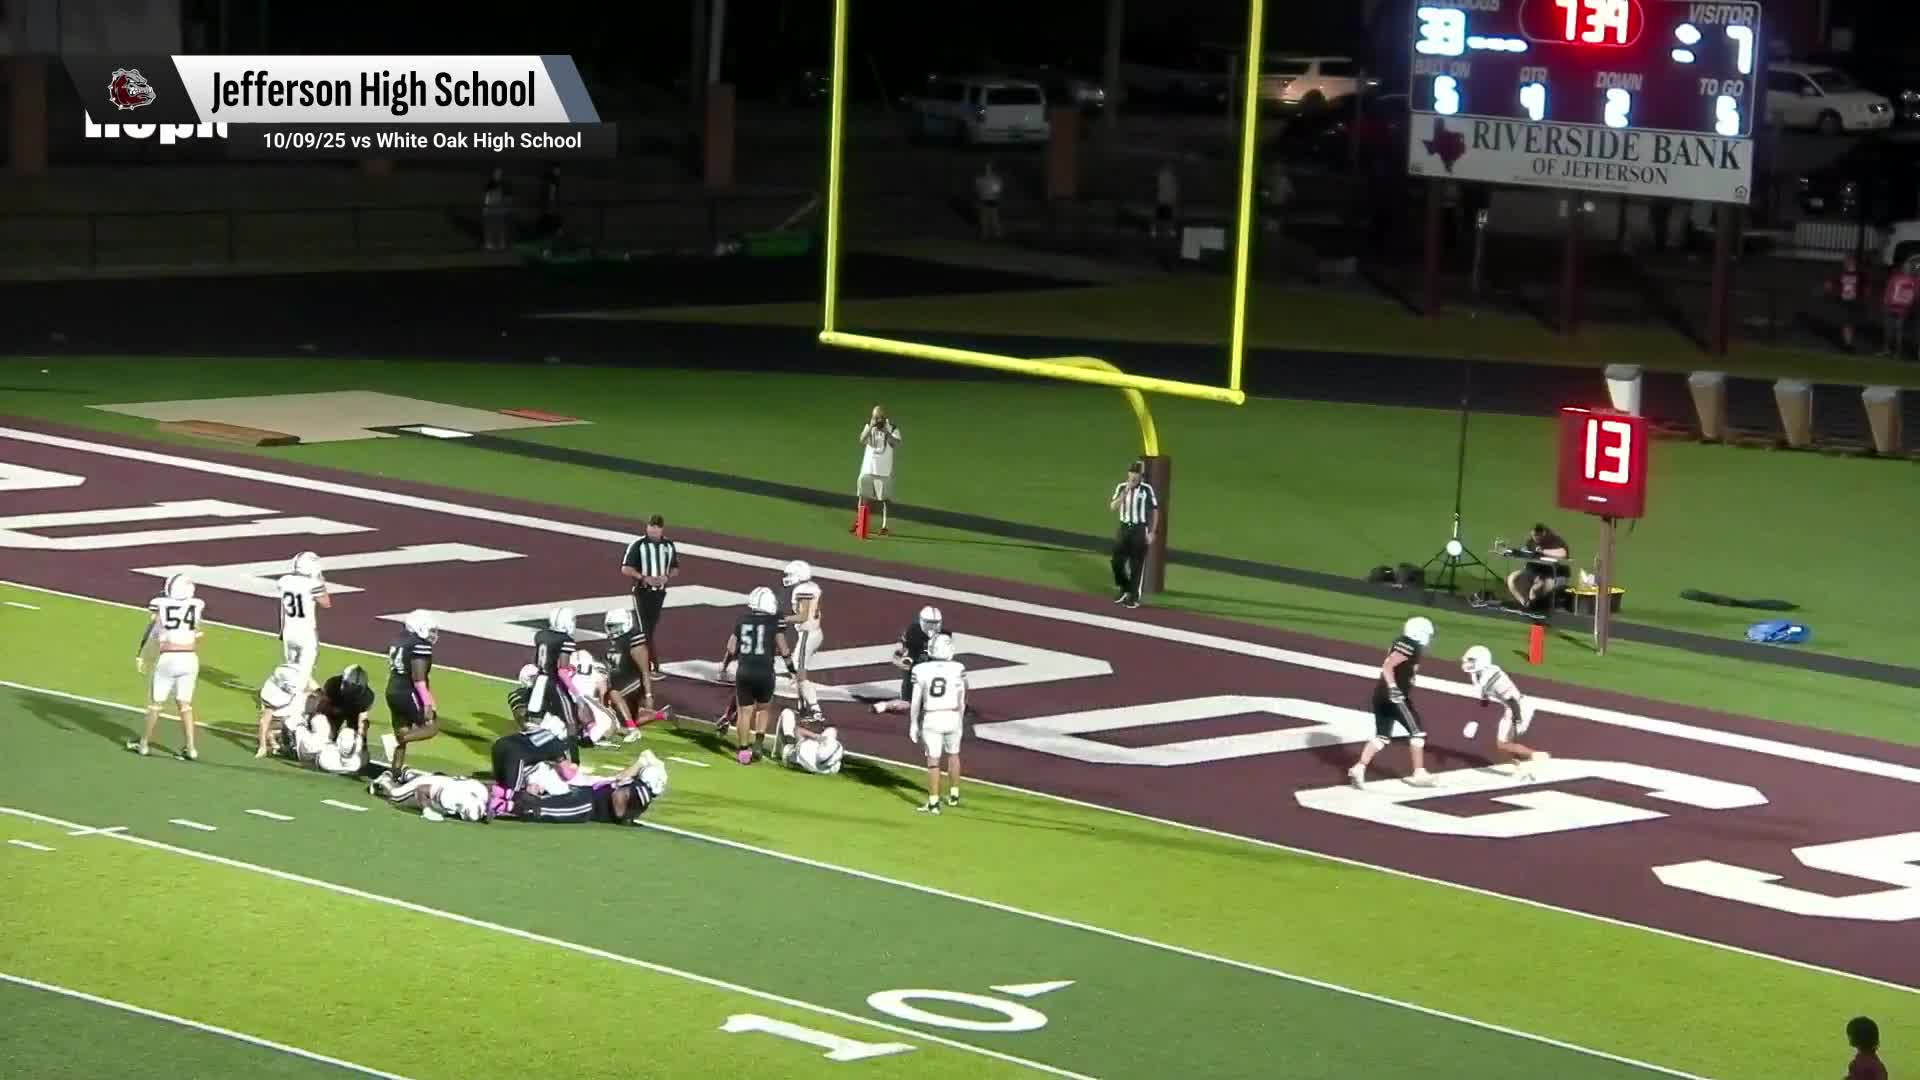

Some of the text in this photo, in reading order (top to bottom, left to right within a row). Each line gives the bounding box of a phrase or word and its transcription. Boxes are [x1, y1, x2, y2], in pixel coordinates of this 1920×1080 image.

[1689, 4, 1754, 25] VISITOR
[1726, 25, 1753, 74] 7
[1596, 72, 1643, 90] DOWN
[1699, 78, 1744, 97] TO GO
[1472, 121, 1741, 170] RIVERSIDE BANK
[1533, 157, 1556, 175] OF
[1562, 161, 1668, 185] JEFFERSON
[1585, 419, 1631, 484] 13
[165, 605, 197, 631] 54
[283, 592, 305, 618] 31
[740, 624, 765, 655] 51
[929, 677, 947, 697] 8
[718, 989, 1048, 1062] 10
